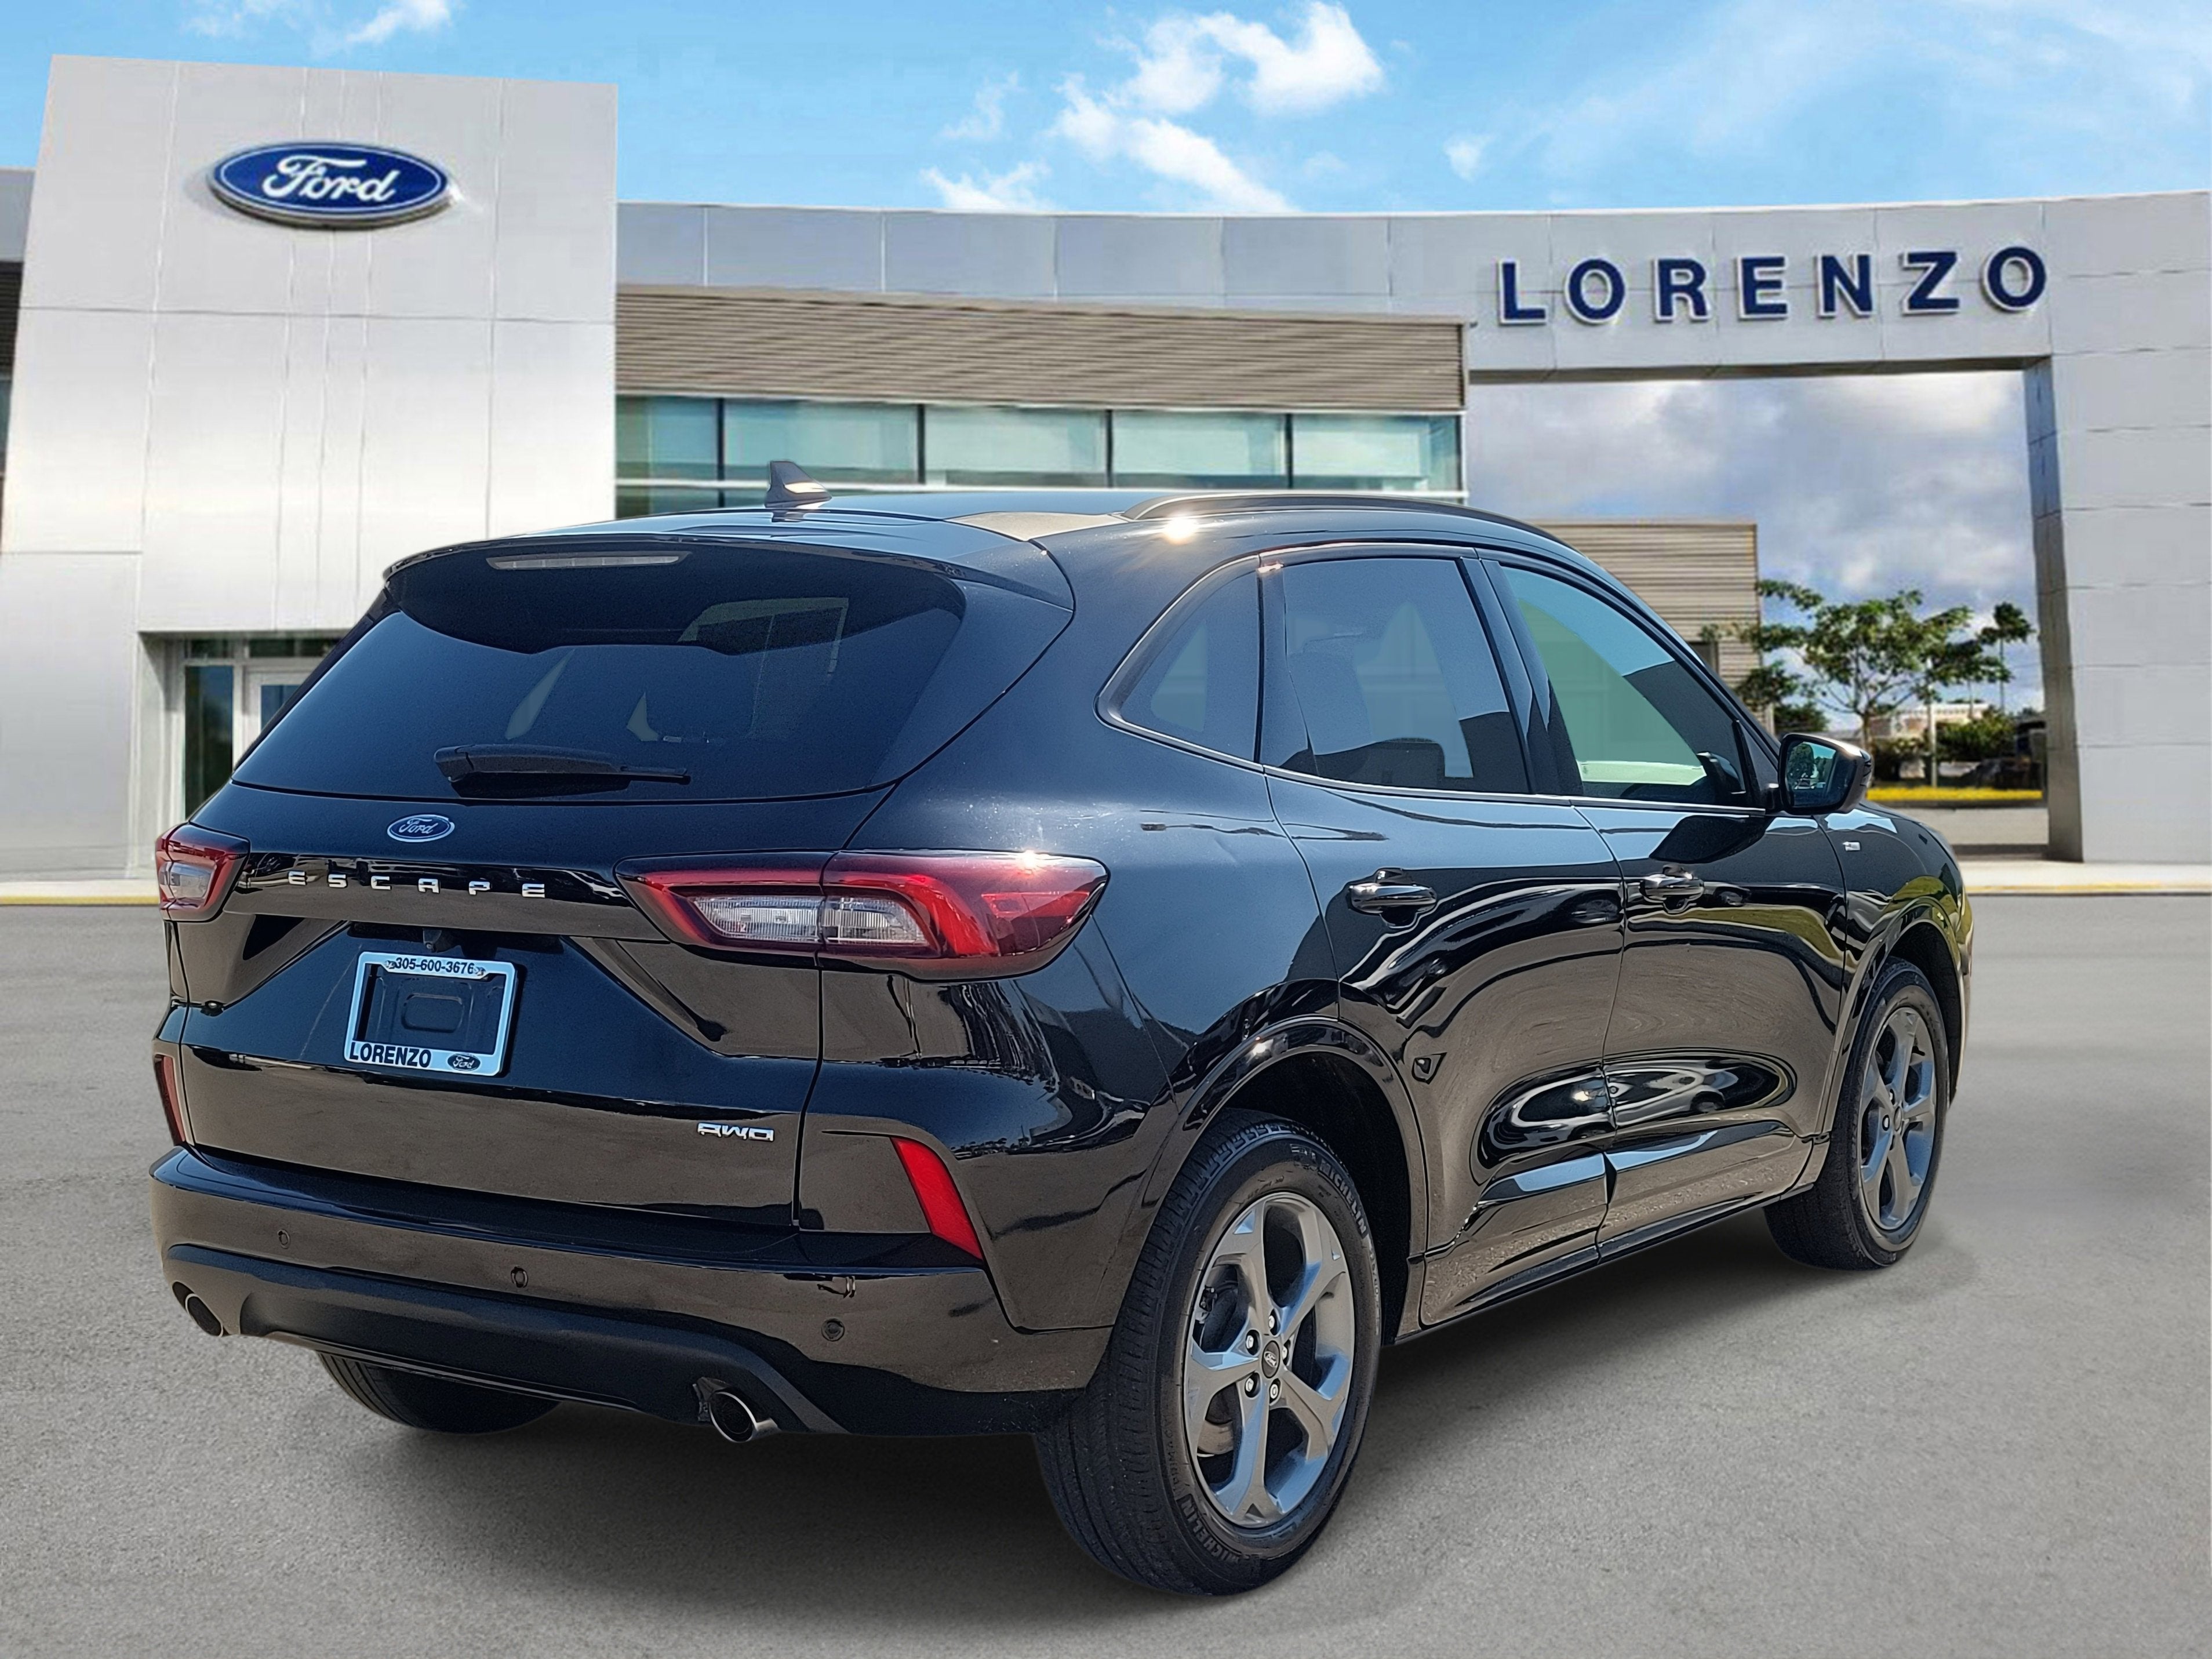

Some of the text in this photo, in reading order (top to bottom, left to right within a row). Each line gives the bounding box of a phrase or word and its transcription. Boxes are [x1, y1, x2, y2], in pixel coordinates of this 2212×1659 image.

[263, 154, 401, 202] Ford
[1498, 247, 2047, 325] LORENZO
[399, 817, 438, 835] Ford
[288, 871, 545, 898] ESCAPE
[395, 957, 474, 975] 305-600-3676
[350, 1042, 431, 1067] LORENZO
[697, 1123, 774, 1141] AWD
[1320, 1159, 1367, 1234] MICHELIN
[1183, 1496, 1240, 1563] MICHELIN
